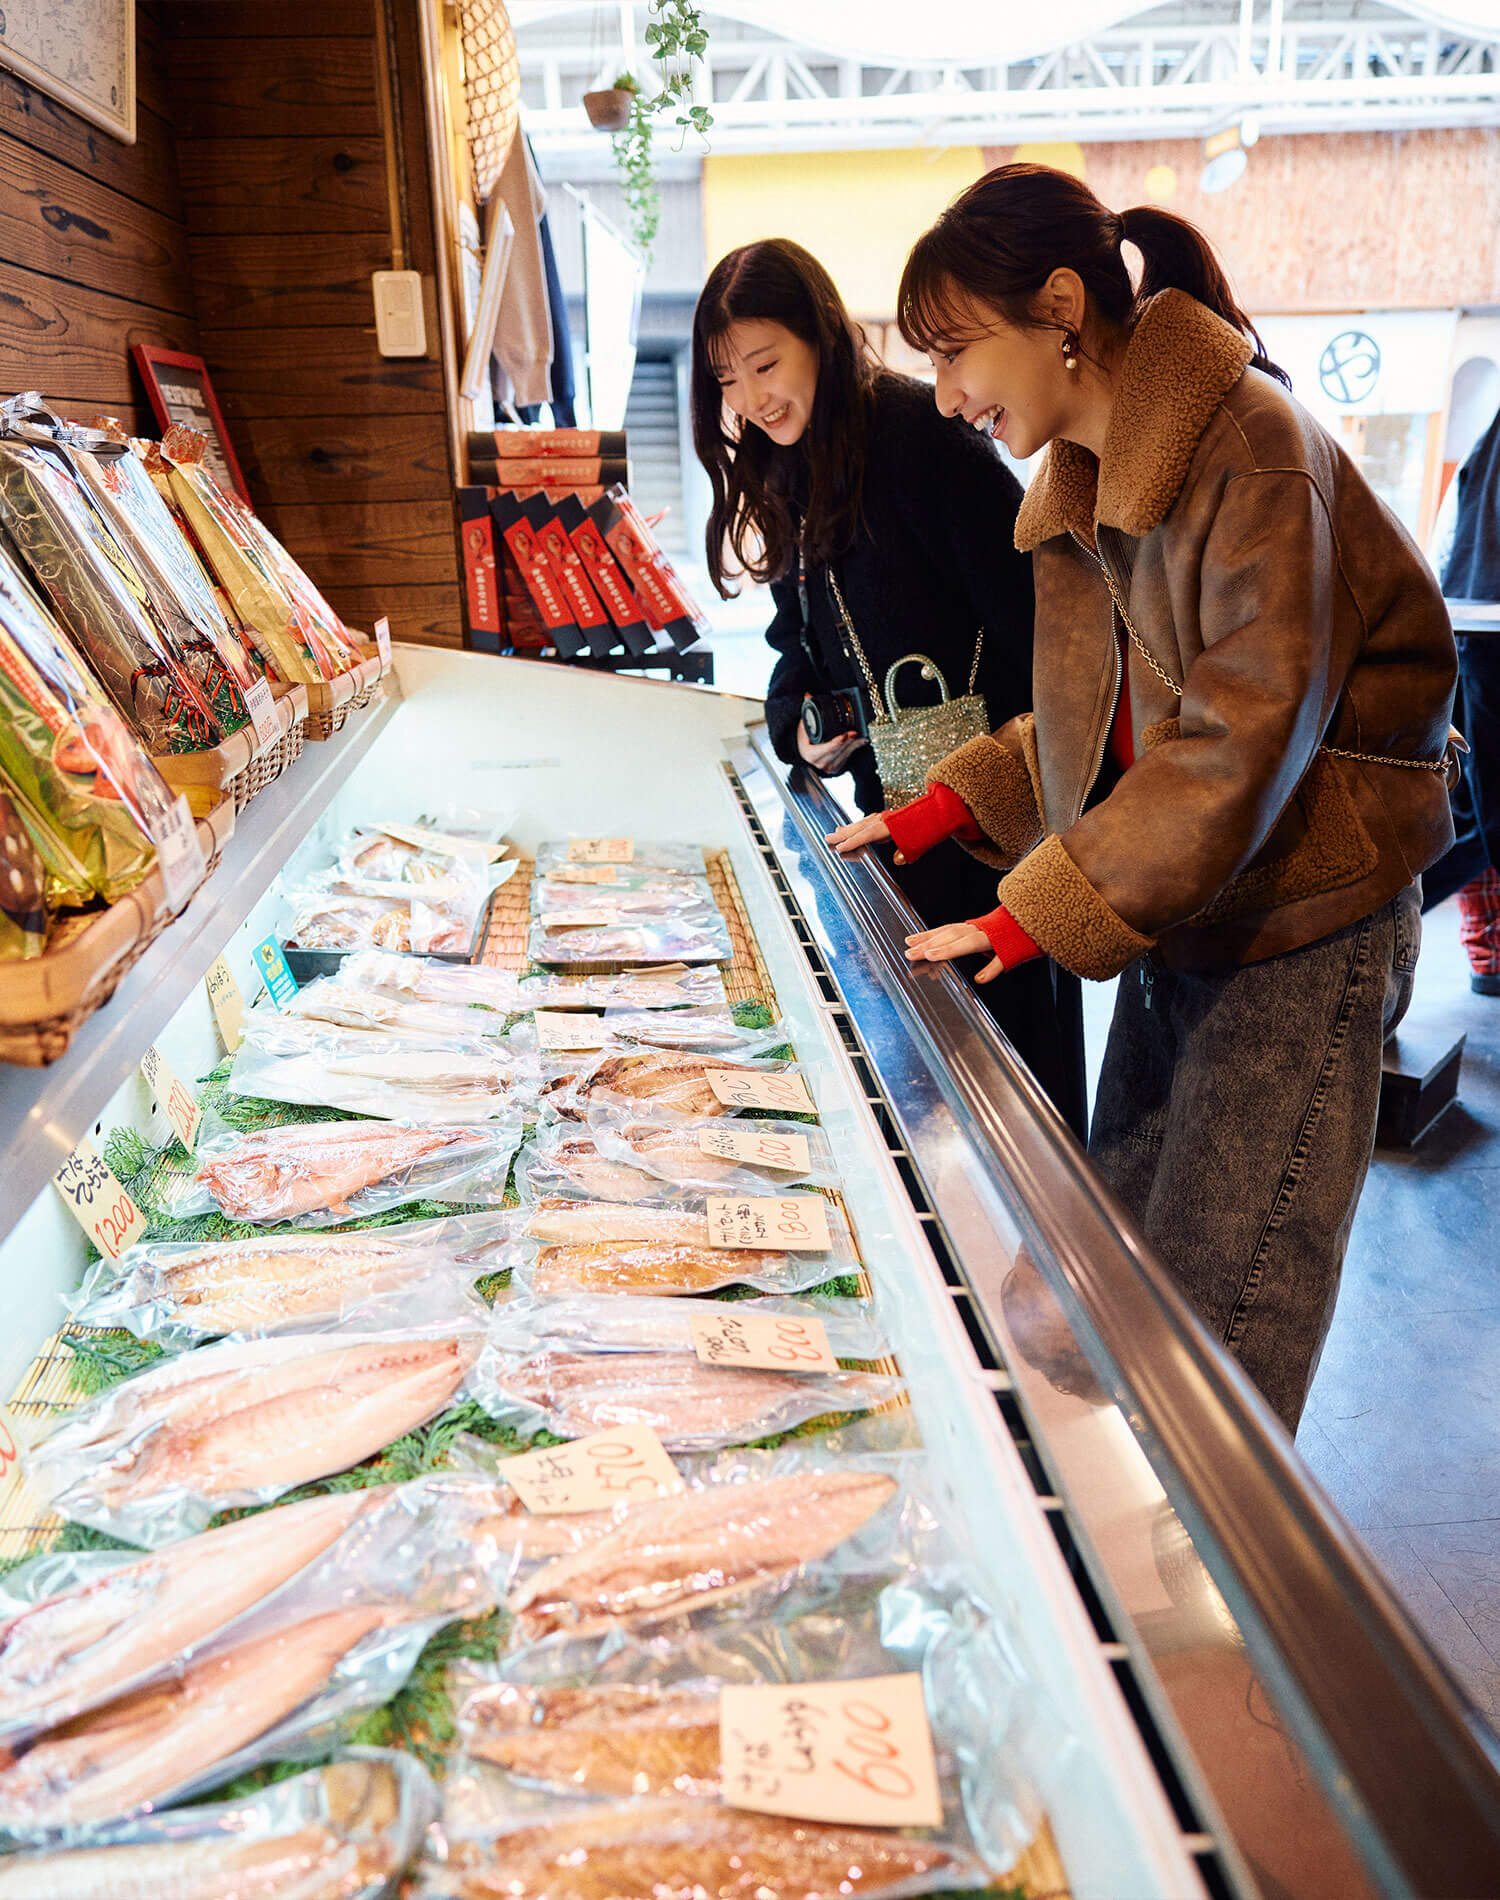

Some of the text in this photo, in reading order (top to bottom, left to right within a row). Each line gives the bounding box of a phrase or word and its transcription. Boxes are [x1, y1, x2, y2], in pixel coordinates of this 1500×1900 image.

[718, 1073, 761, 1106] あじ
[760, 1075, 807, 1110] 600
[756, 1138, 796, 1167] 650
[75, 1154, 109, 1206] ひらき
[95, 1194, 136, 1260] 1,200
[833, 1701, 916, 1799] 600
